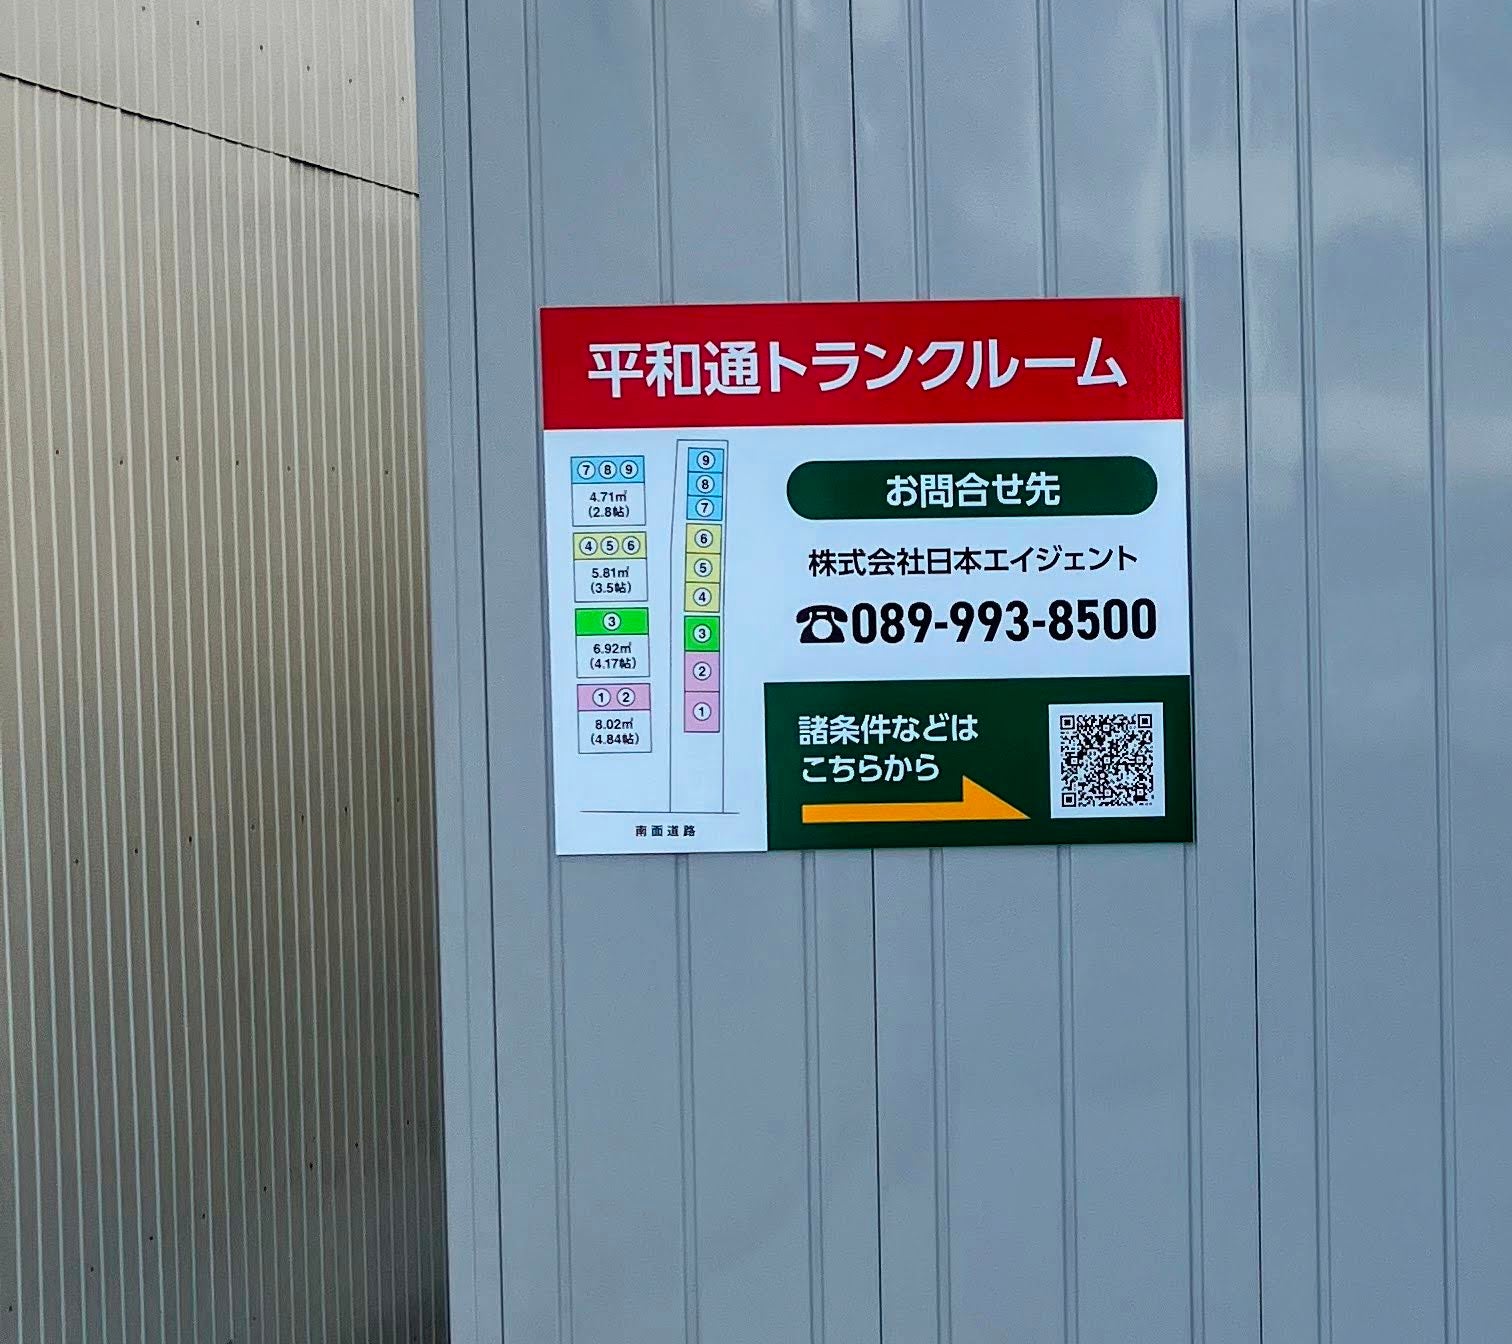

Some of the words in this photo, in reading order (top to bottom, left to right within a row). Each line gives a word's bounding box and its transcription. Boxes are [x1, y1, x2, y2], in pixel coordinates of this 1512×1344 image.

[588, 337, 1128, 398] 平和通トランクルーム
[886, 471, 1060, 508] お問合せ先
[808, 545, 1137, 577] 株式会社日本エイジェント
[852, 598, 1157, 644] 089-993-8500
[798, 713, 979, 746] 諸条件などは
[802, 754, 940, 783] こちらから
[635, 824, 696, 837] 南面道路
